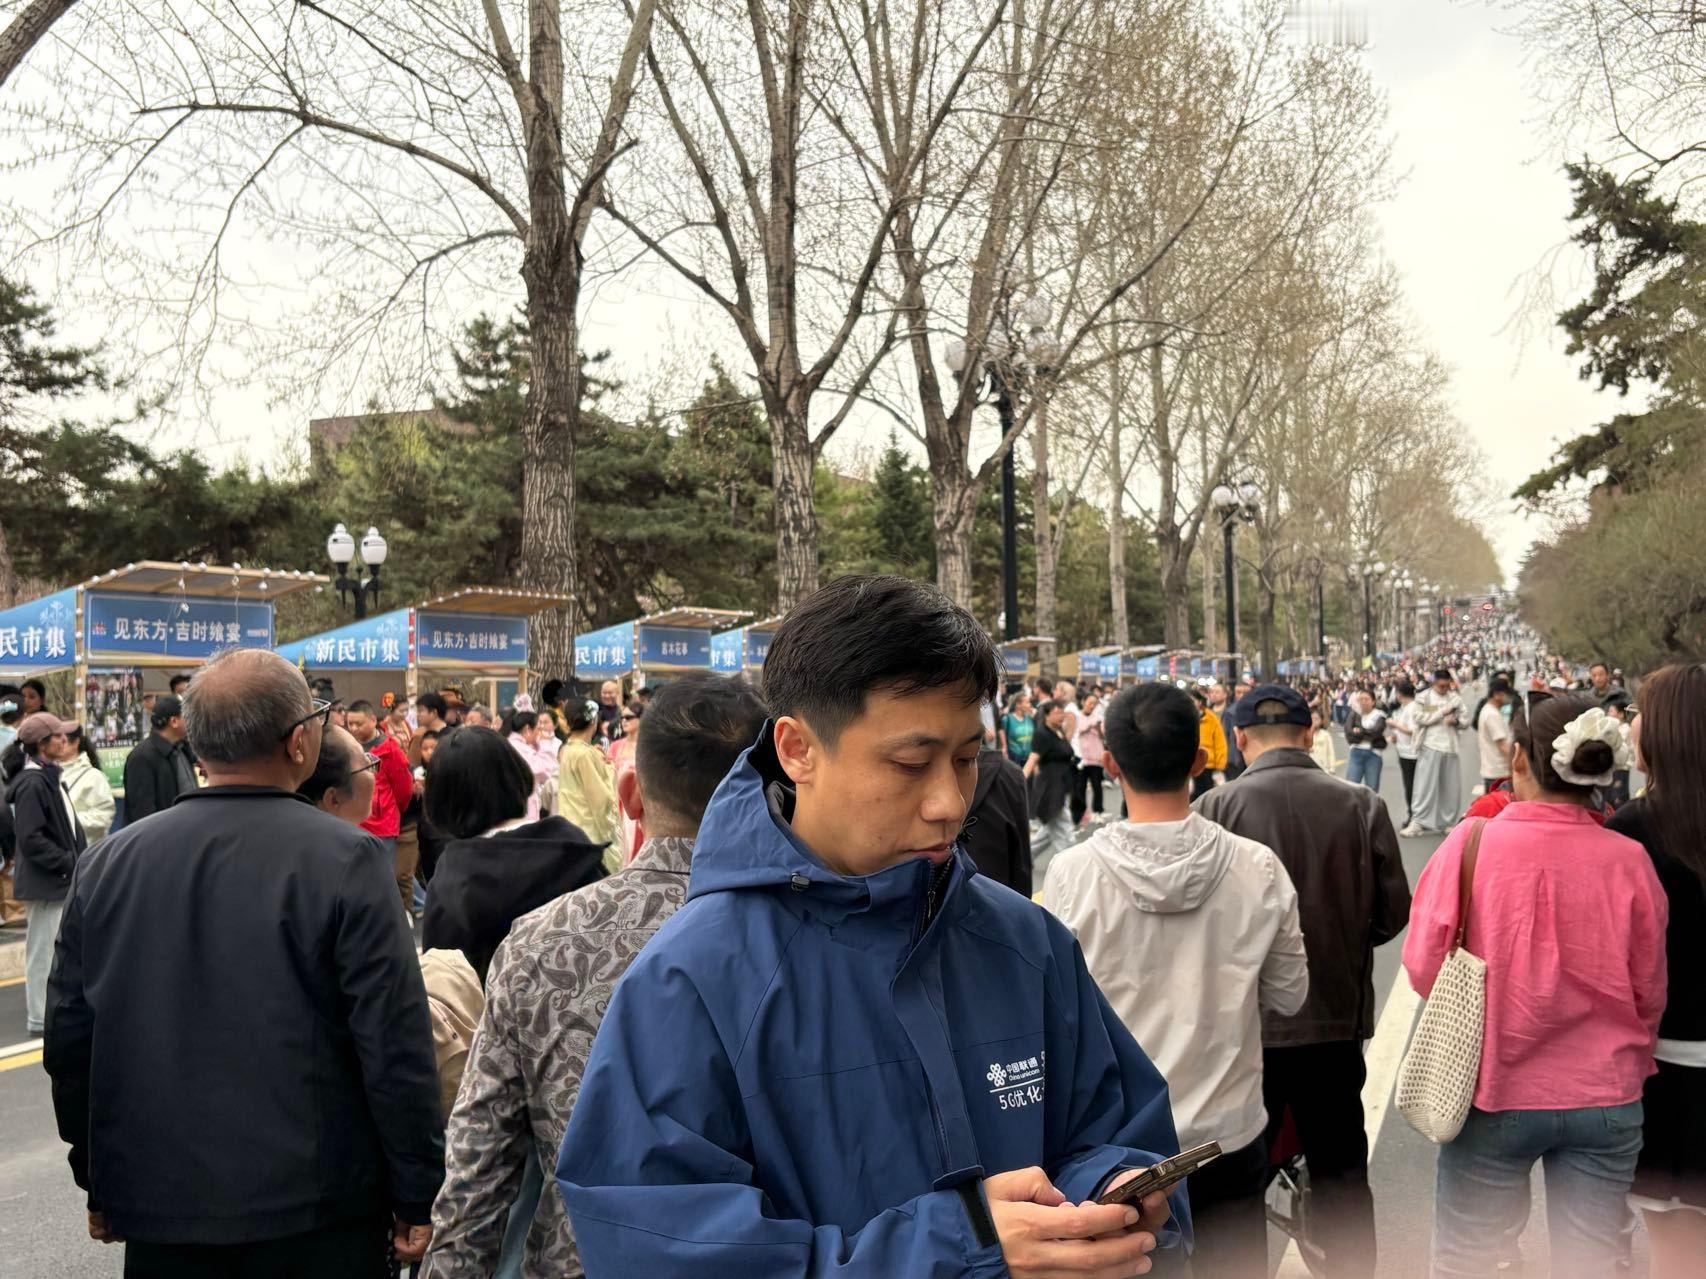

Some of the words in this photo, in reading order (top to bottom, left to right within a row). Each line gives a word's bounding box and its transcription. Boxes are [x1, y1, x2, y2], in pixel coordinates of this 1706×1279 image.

[0, 626, 66, 658] 民市集
[316, 637, 400, 663] 新民市集
[575, 645, 626, 666] 民市集
[1006, 1057, 1038, 1073] 中国联通
[999, 1086, 1044, 1110] 5G优化
